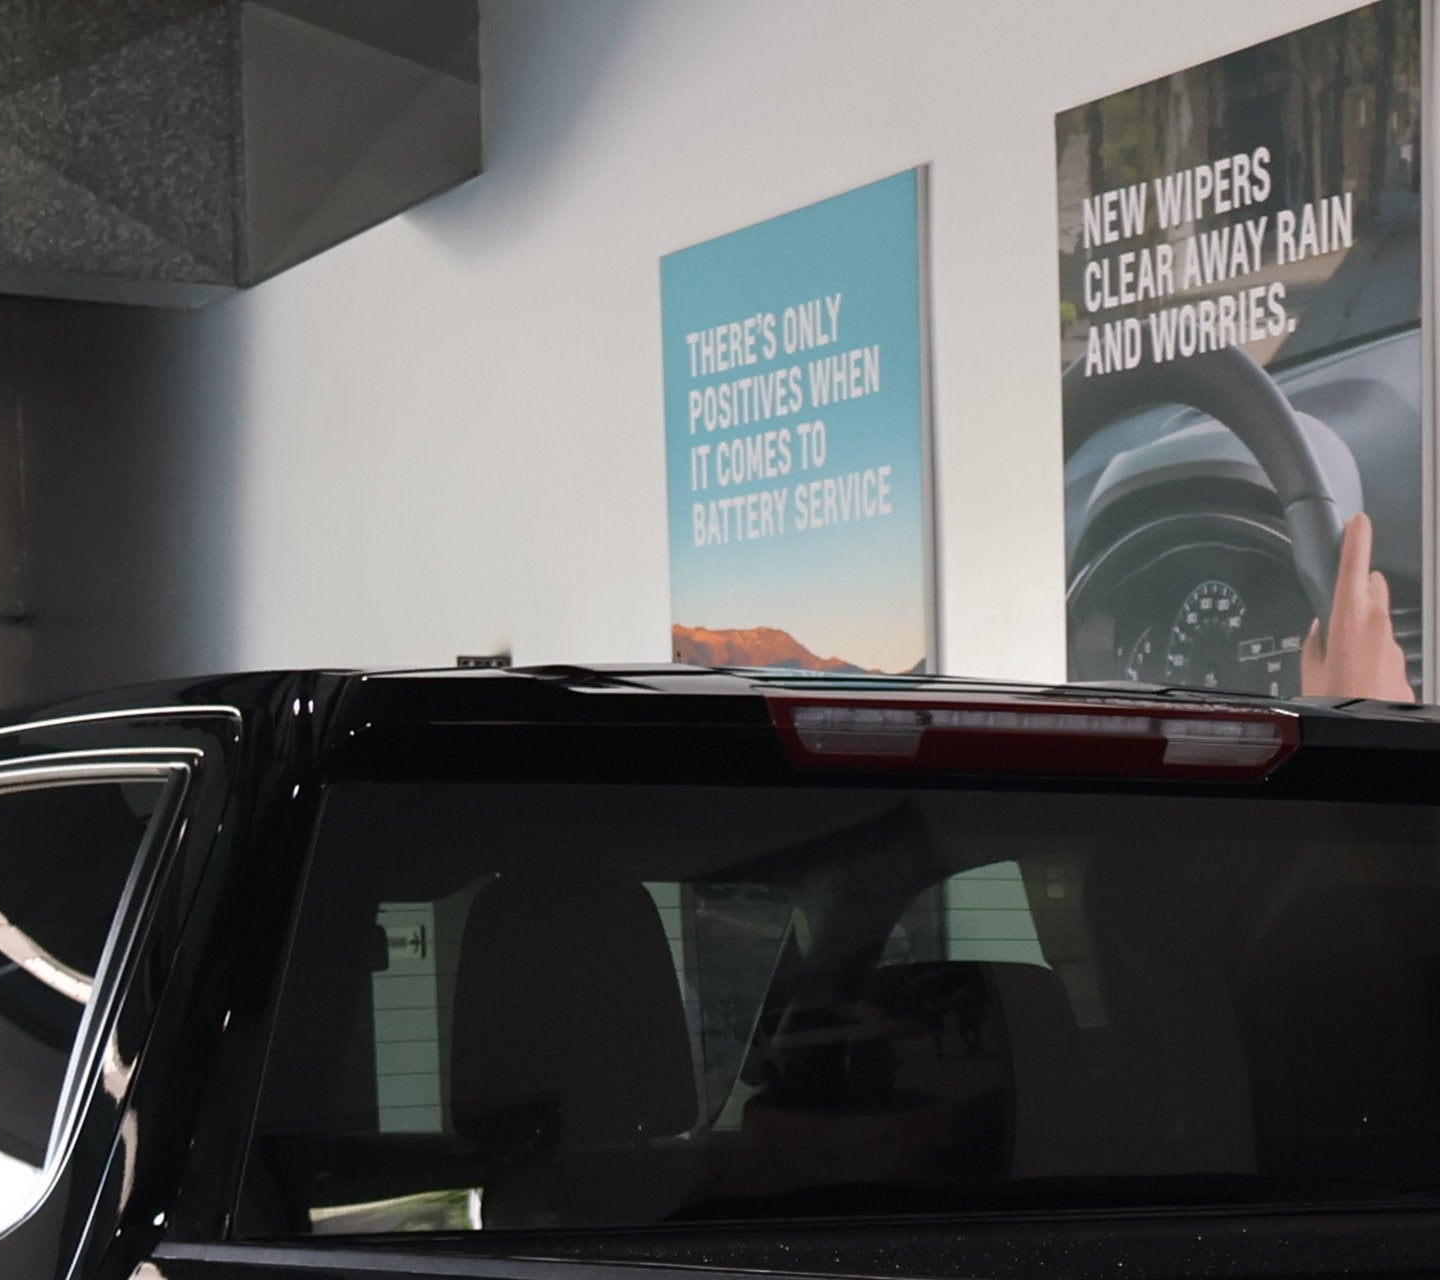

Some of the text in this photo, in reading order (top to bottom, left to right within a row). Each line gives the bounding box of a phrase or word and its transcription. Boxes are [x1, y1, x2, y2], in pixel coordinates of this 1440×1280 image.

[1083, 146, 1271, 249] NEW WIPERS
[1084, 192, 1353, 313] CLEAR AWAY RAIN
[686, 293, 842, 377] THERE'S ONLY
[1085, 282, 1297, 377] AND WORRIES.
[689, 345, 881, 434] POSITIVES WHEN
[691, 420, 826, 491] IT COMES TO
[693, 466, 892, 547] BATTERY SERVICE
